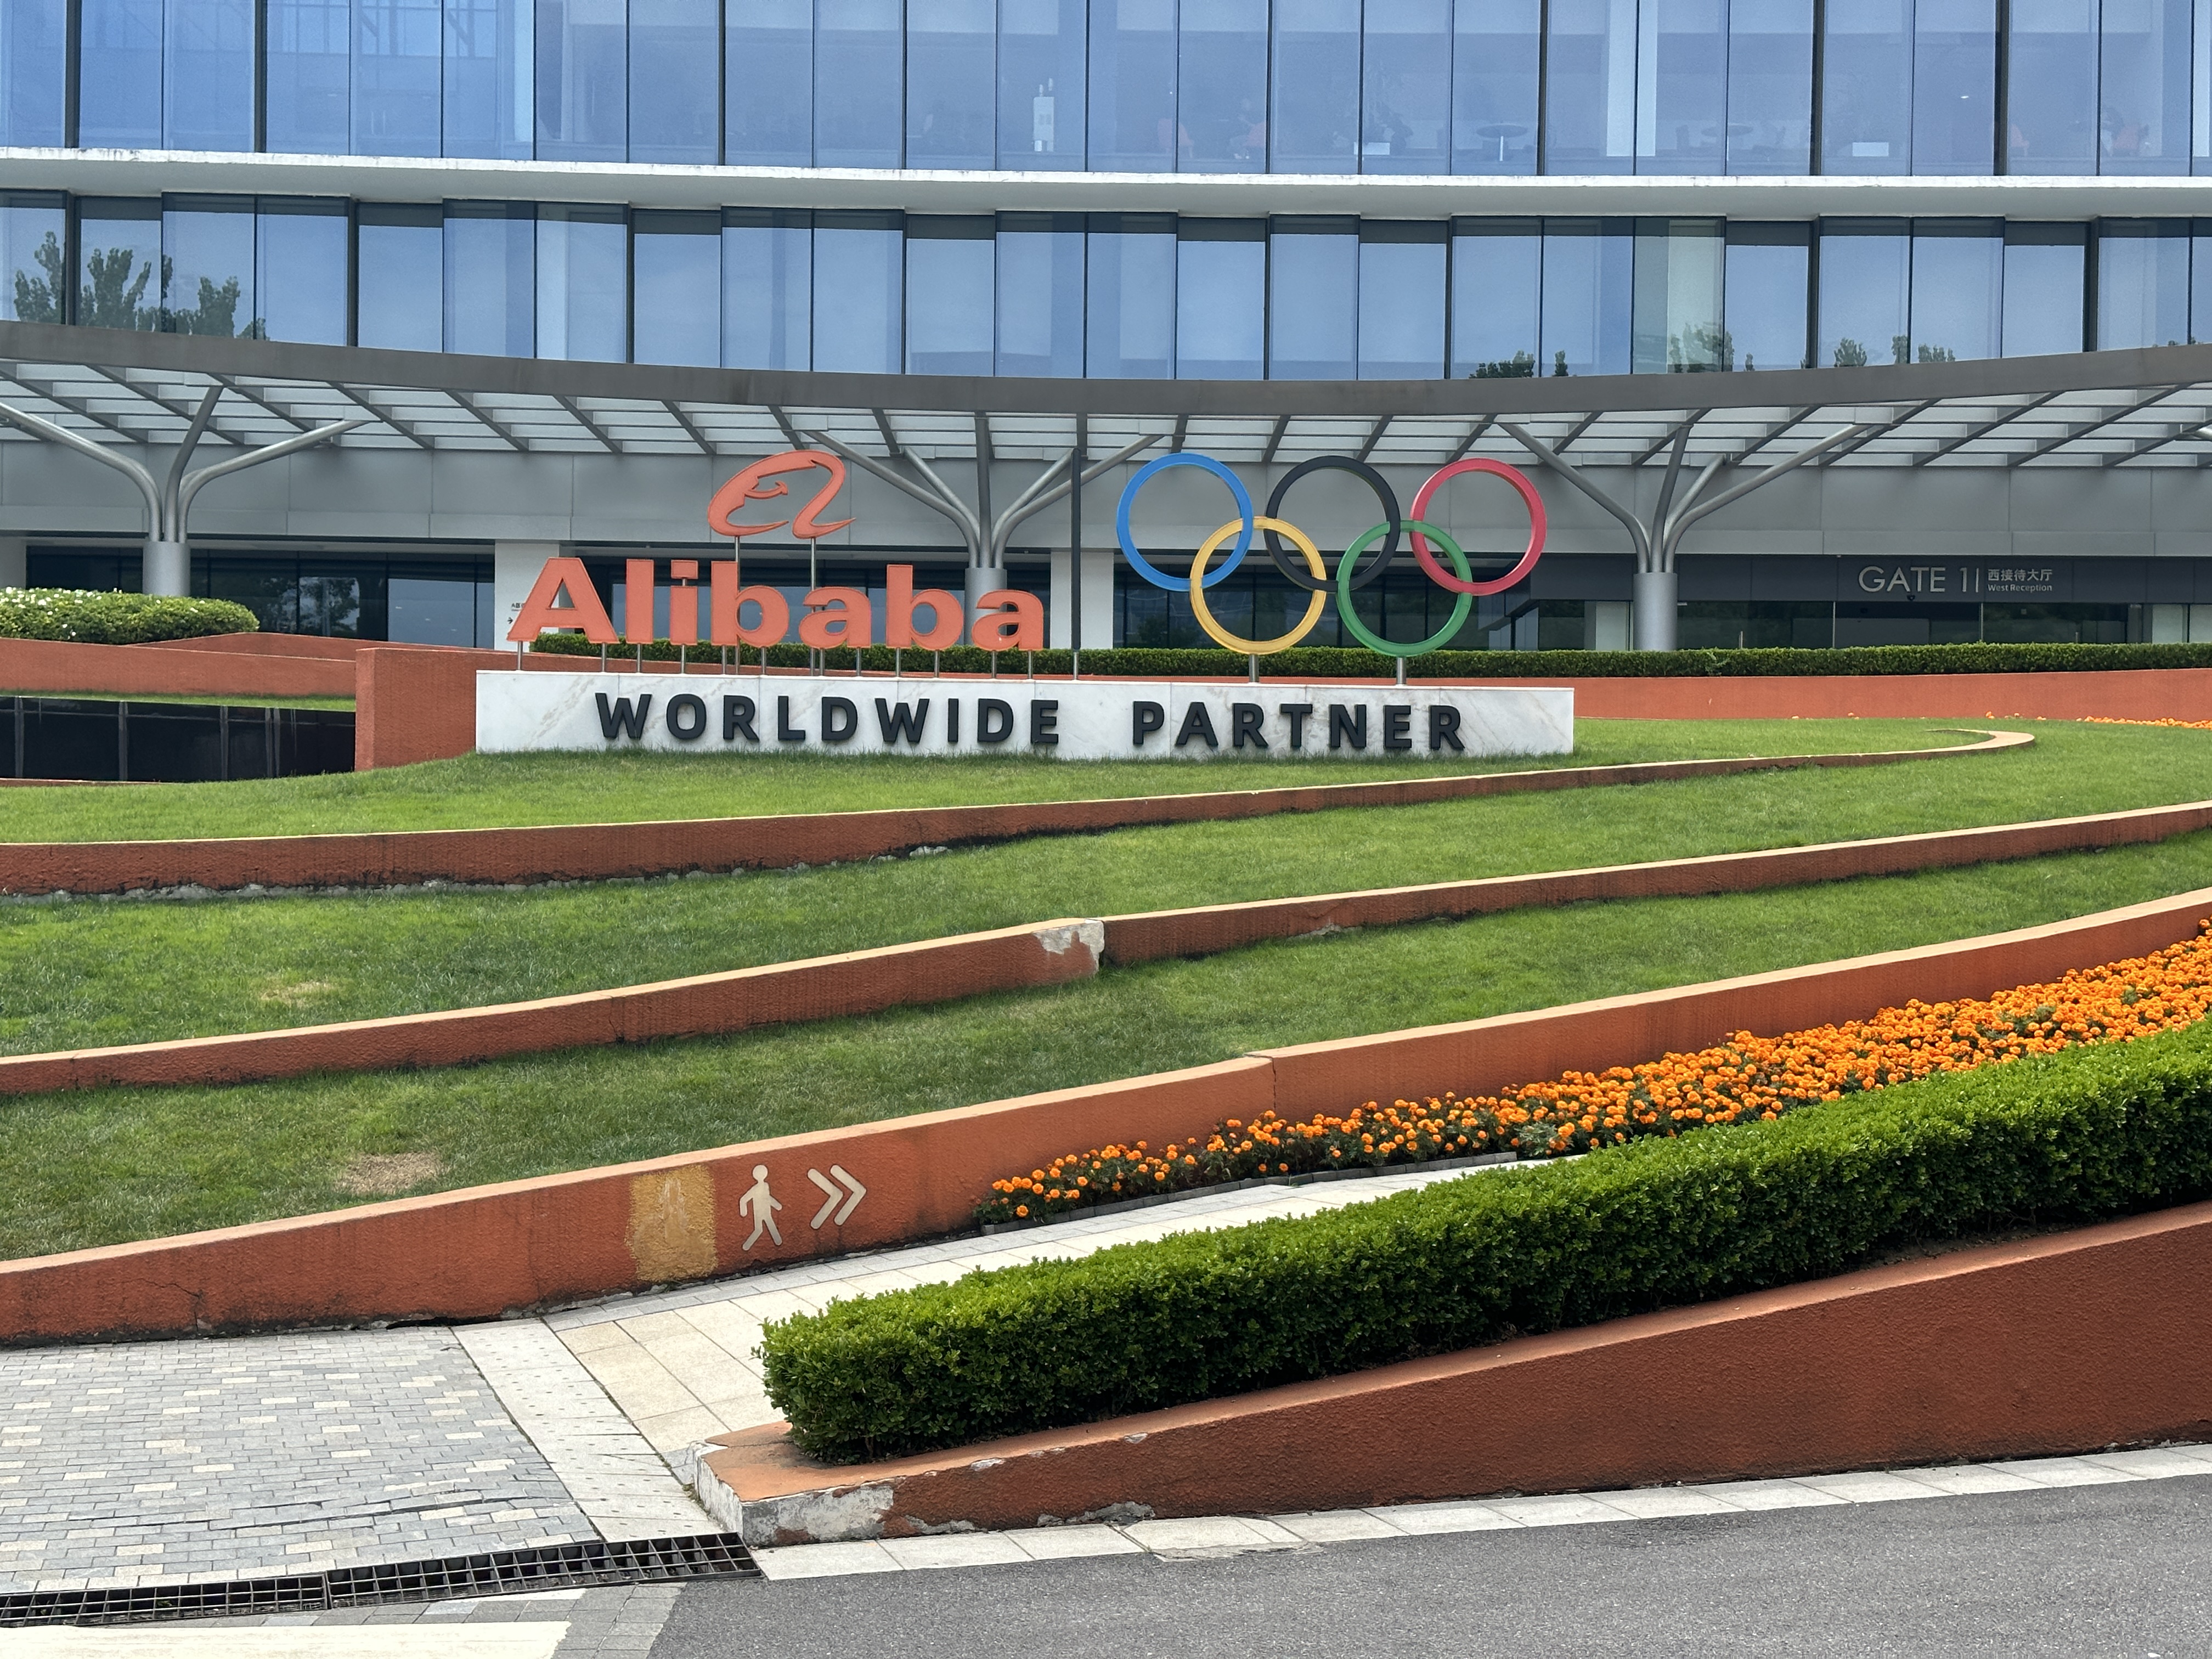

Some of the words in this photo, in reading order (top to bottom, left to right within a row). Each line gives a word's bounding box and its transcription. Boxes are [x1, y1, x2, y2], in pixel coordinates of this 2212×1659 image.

[1858, 566, 1946, 593] GATE
[1960, 567, 1968, 592] 1
[1988, 568, 2053, 582] 西接待大厅
[1988, 583, 2008, 591] West
[2010, 583, 2053, 593] Reception
[506, 557, 1044, 651] Alibaba
[595, 692, 1059, 744] WORLDWIDE
[1132, 700, 1465, 751] PARTNER
